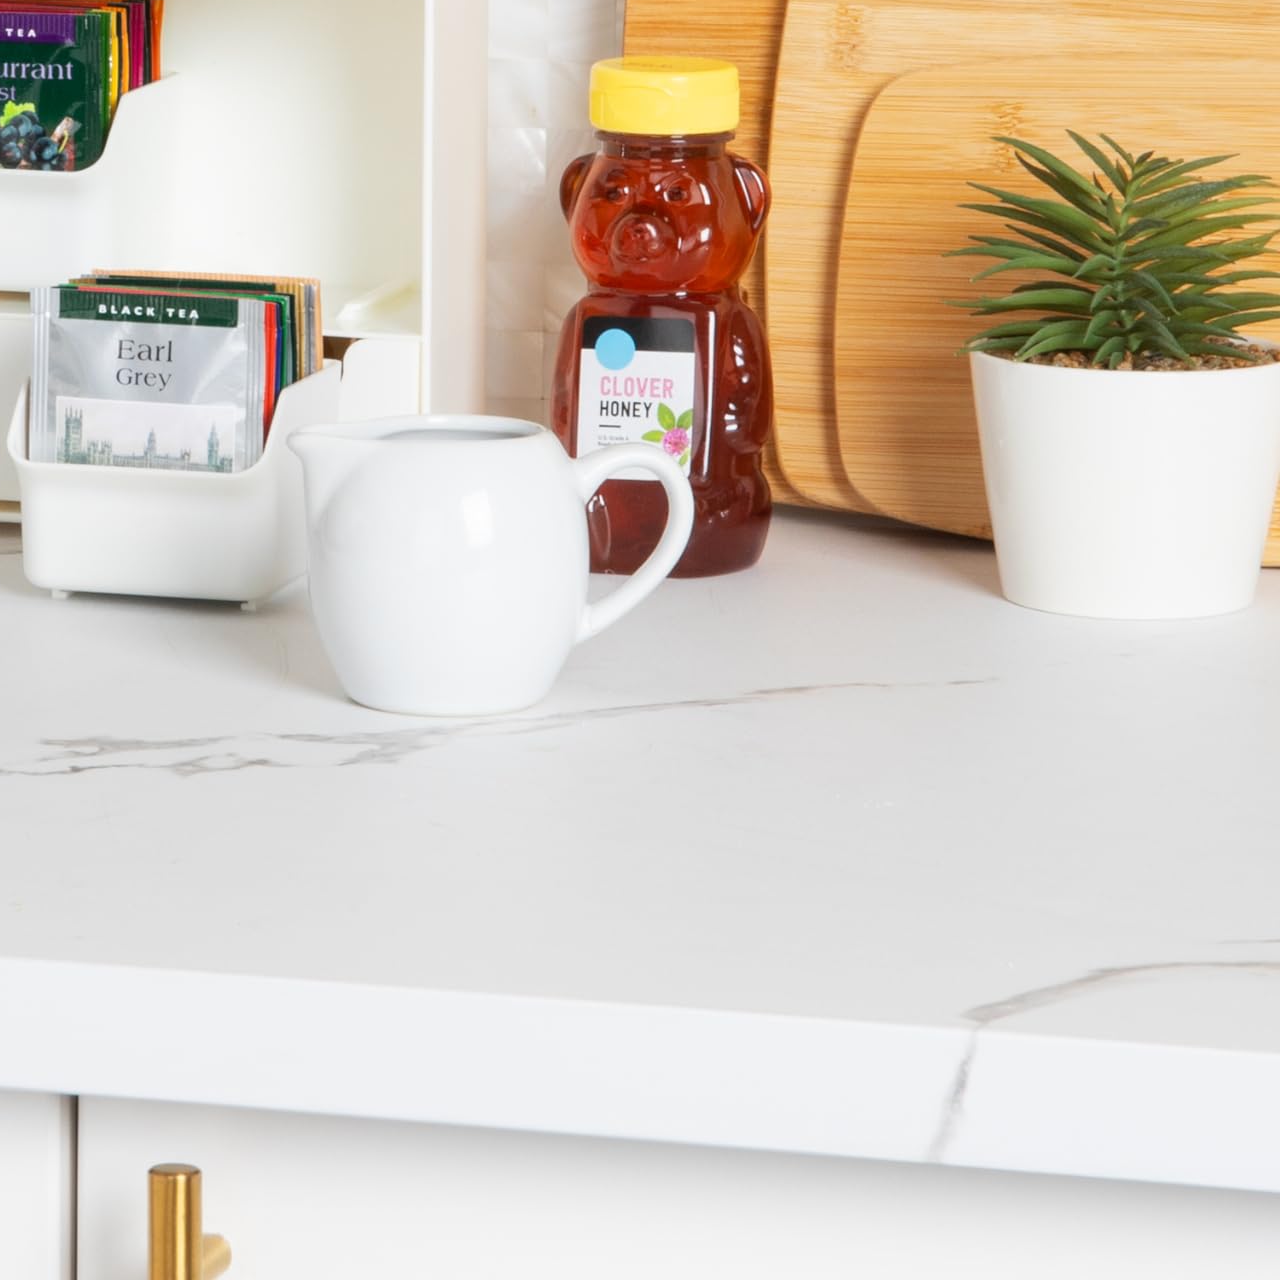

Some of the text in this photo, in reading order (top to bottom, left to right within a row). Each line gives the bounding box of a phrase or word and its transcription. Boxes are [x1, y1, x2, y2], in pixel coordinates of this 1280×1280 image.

[5, 27, 38, 38] TEA
[98, 304, 200, 319] BLACK TEA
[116, 339, 173, 363] Earl
[115, 368, 172, 391] Grey
[600, 376, 674, 398] CLOVER
[599, 400, 653, 419] HONEY
